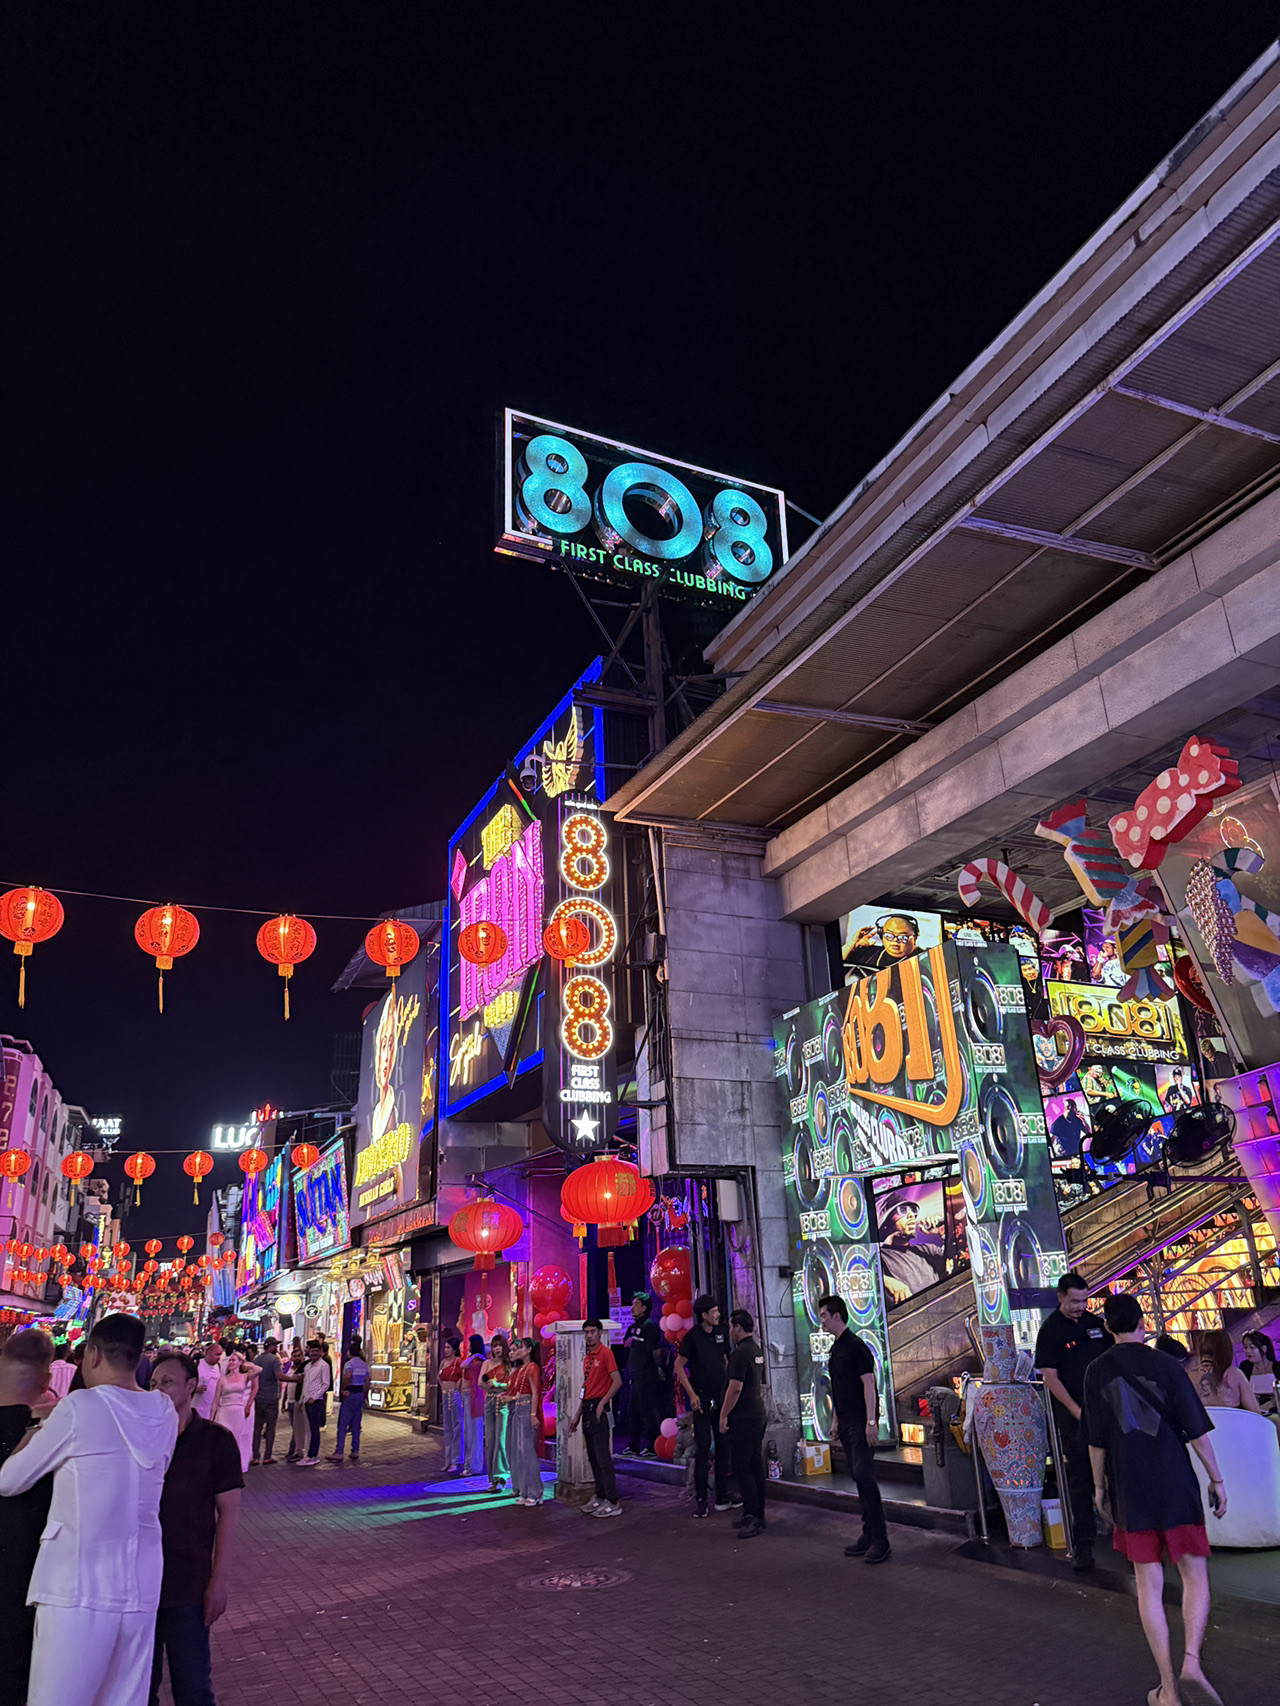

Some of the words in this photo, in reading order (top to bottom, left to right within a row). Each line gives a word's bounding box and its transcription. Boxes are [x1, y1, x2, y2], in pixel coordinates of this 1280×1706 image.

[518, 434, 773, 583] 808
[560, 540, 607, 565] FIRST
[613, 553, 660, 578] CLASS
[1093, 1044, 1127, 1056] CLASS
[1128, 1047, 1180, 1060] CLUBBING
[571, 1064, 600, 1077] FIRST
[571, 1077, 600, 1090] CLASS
[560, 1089, 611, 1103] CLUBBING
